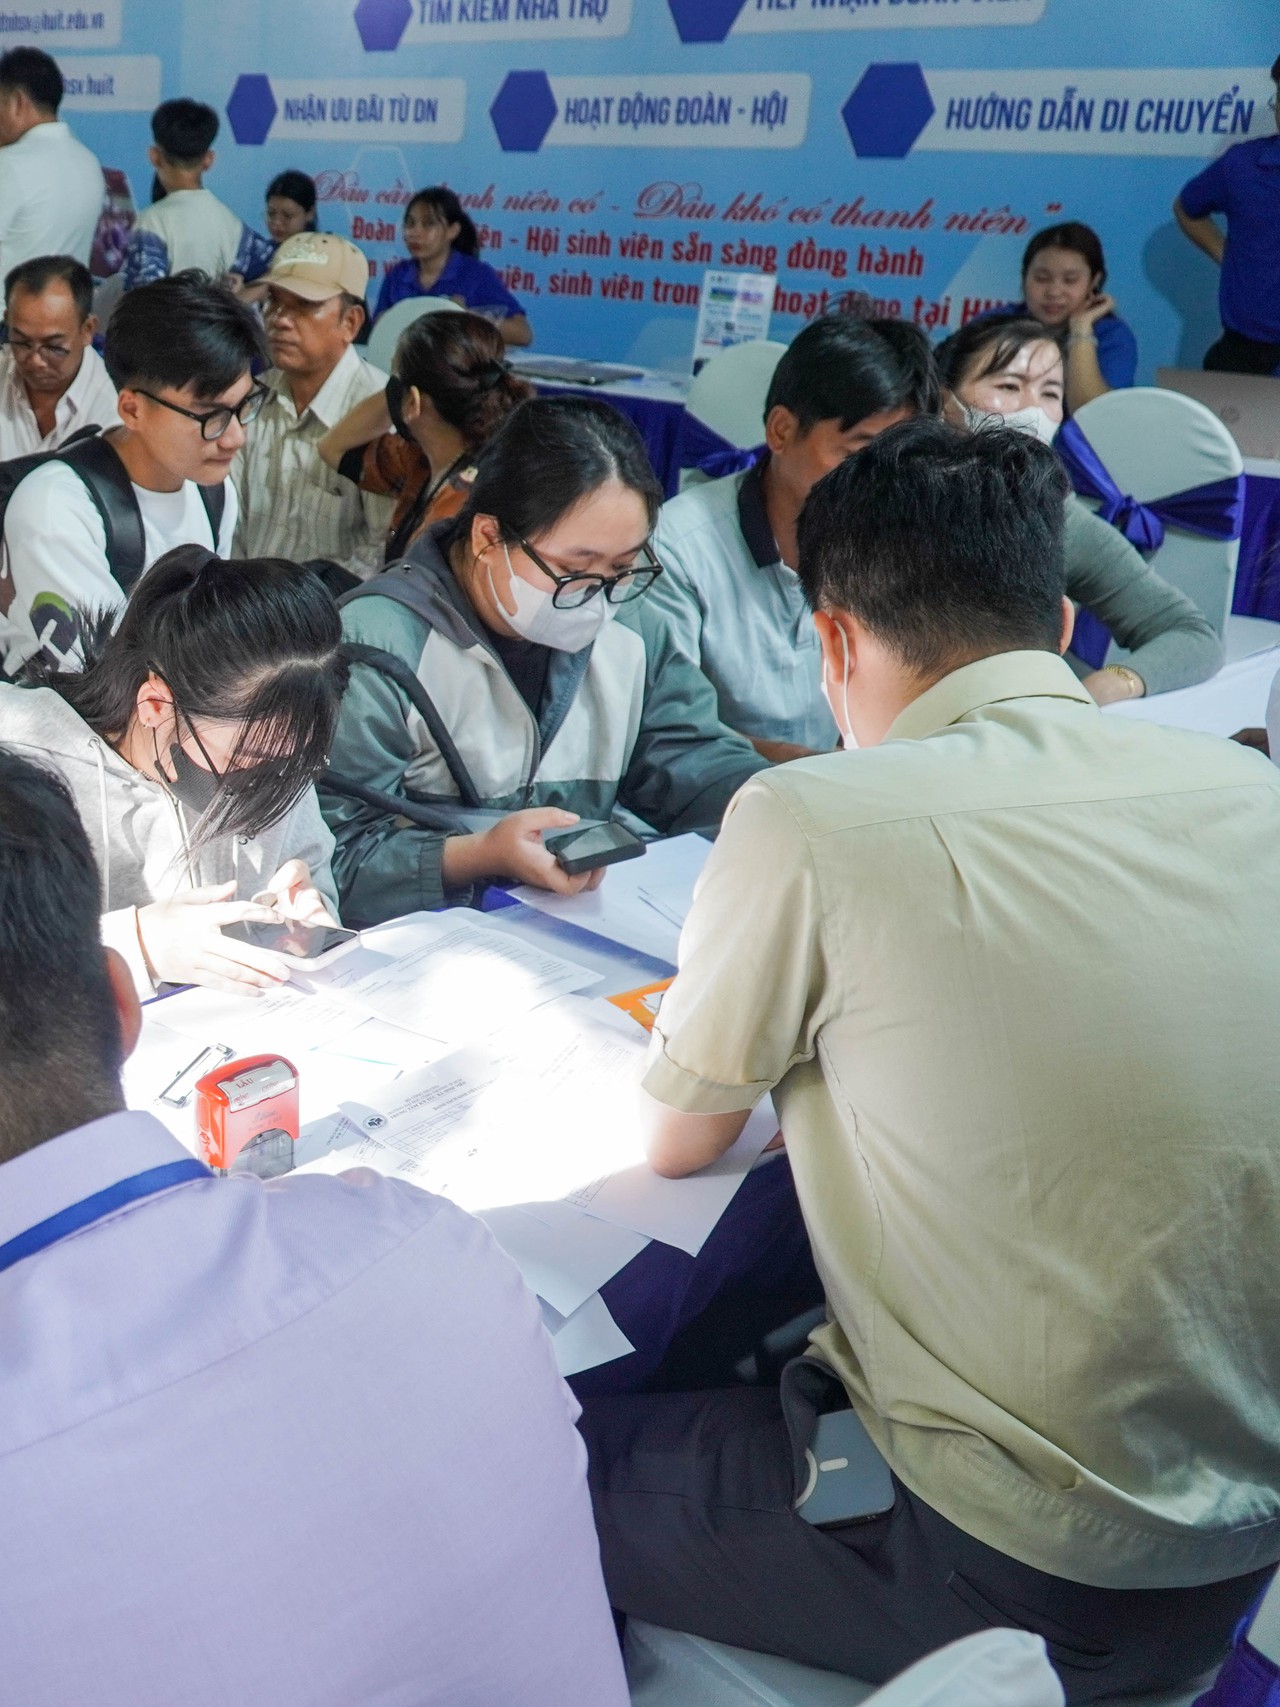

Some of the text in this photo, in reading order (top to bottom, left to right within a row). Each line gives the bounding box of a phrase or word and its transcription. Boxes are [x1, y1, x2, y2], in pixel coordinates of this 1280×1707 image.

[284, 92, 326, 126] NHẬN
[413, 97, 439, 123] DN
[564, 96, 614, 131] HOẠT
[617, 90, 671, 131] ĐỘNG
[674, 90, 733, 126] ĐOÀN
[750, 89, 789, 131] HỘI
[944, 84, 1255, 136] HƯỚNG DẪN DI CHUYỂN
[830, 196, 935, 232] thanh
[351, 215, 396, 242] Đoàn
[526, 225, 560, 257] Hội
[566, 227, 612, 257] sinh
[618, 231, 665, 260] viên
[720, 237, 778, 274] sàng
[786, 236, 848, 279] đồng
[857, 243, 925, 277] hành
[548, 269, 594, 297] sinh
[600, 272, 644, 301] viên
[652, 276, 701, 305] tron
[912, 295, 951, 332] tại
